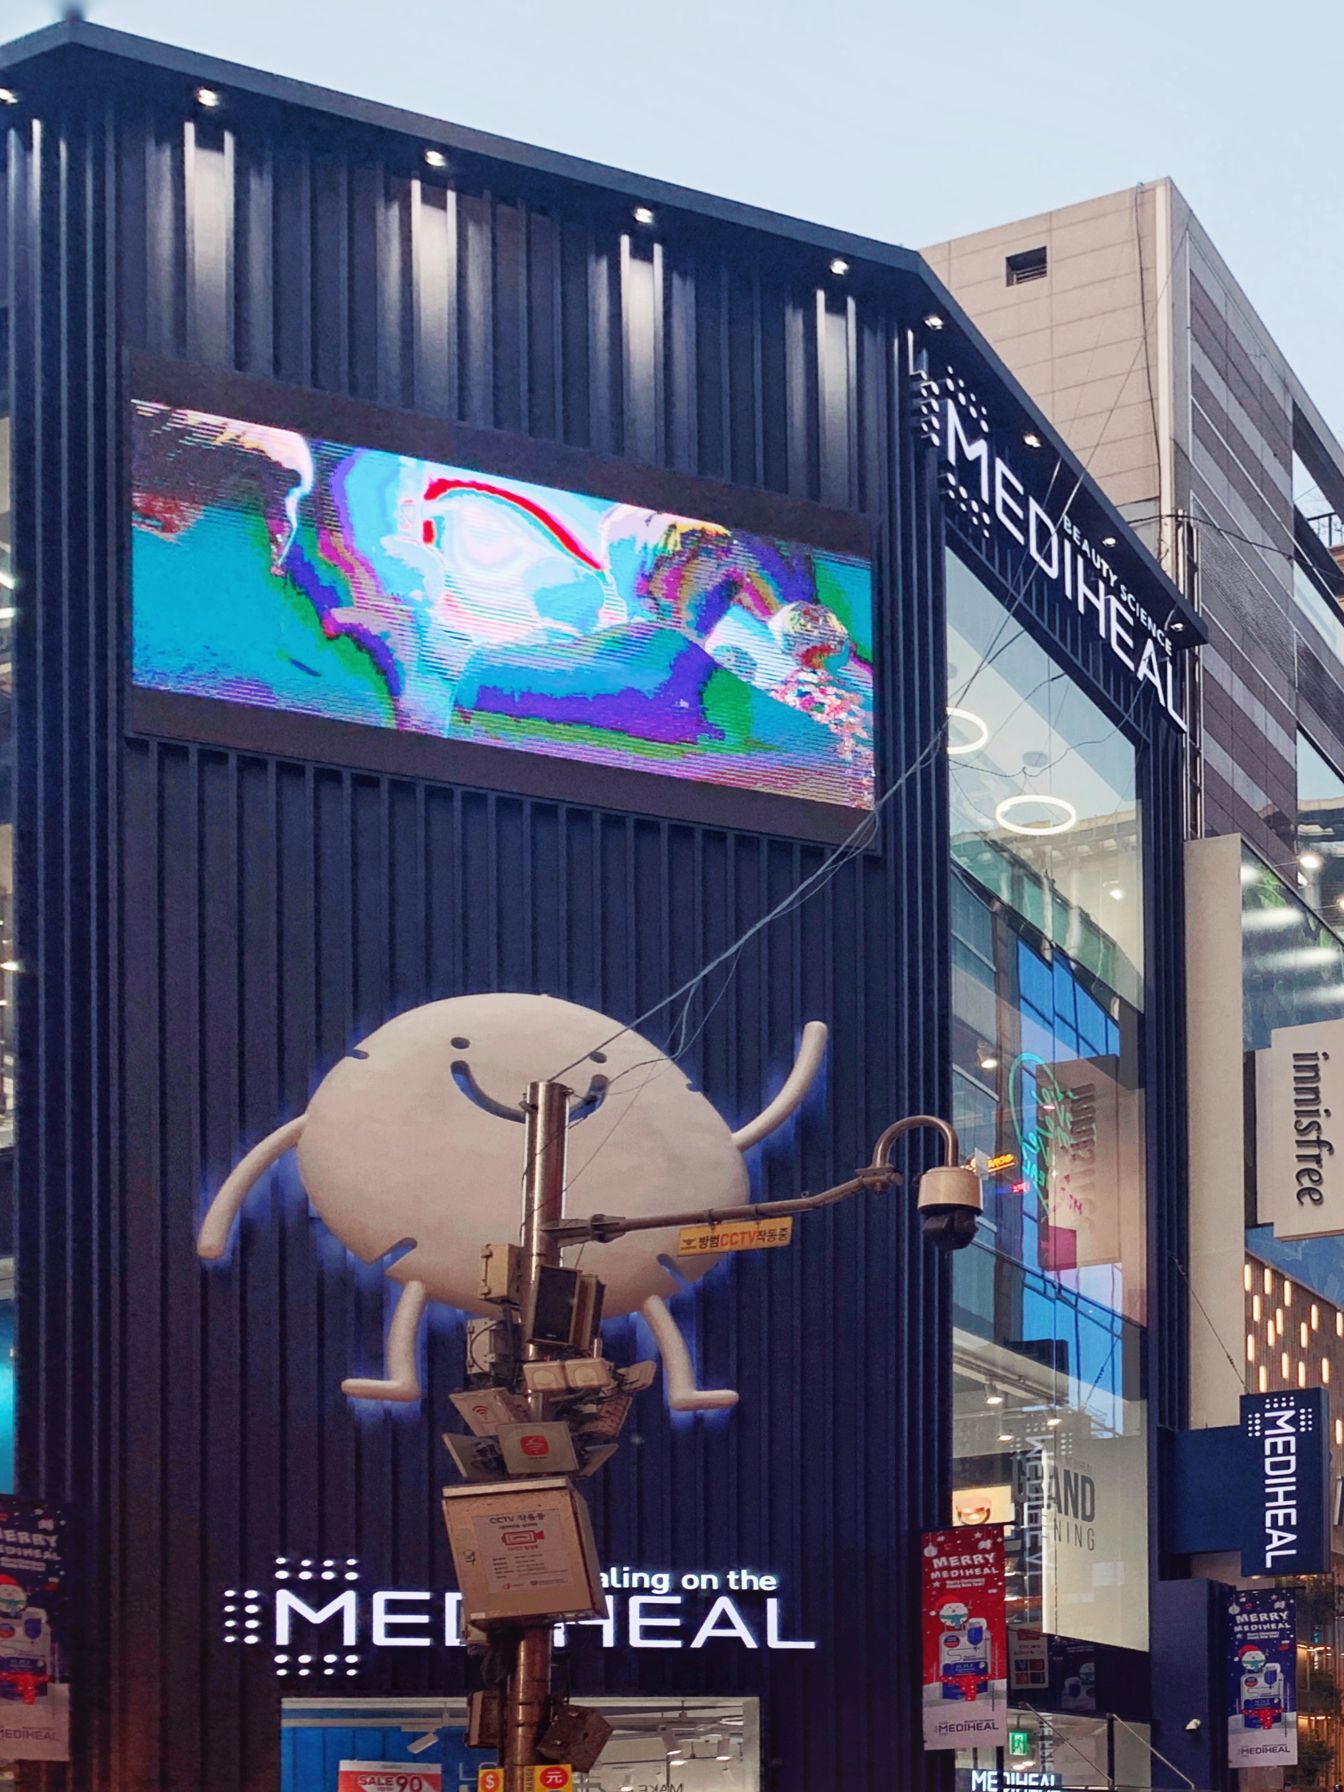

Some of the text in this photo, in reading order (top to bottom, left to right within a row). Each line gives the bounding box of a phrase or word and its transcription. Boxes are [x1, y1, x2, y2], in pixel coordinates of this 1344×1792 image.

[947, 398, 1188, 733] MEDIHEAL
[1062, 514, 1173, 656] BEAUTY SCIENCE
[1293, 1051, 1335, 1208] innisfree
[1264, 1409, 1297, 1569] MEDIHEAL
[489, 1516, 514, 1524] CCTV
[0, 1527, 58, 1547] ERRY
[0, 1545, 62, 1560] EDIHEAL
[932, 1553, 996, 1569] MERRY
[600, 1567, 777, 1594] aling on the
[930, 1567, 999, 1579] MEDIHEAL
[275, 1589, 815, 1649] MEHEAL
[1235, 1611, 1289, 1624] MERRY
[1234, 1622, 1291, 1632] MEDIHEAL
[938, 1721, 999, 1733] MEDIHEAL
[1241, 1744, 1290, 1756] MEDIHEAL
[358, 1775, 423, 1792] SALE 90
